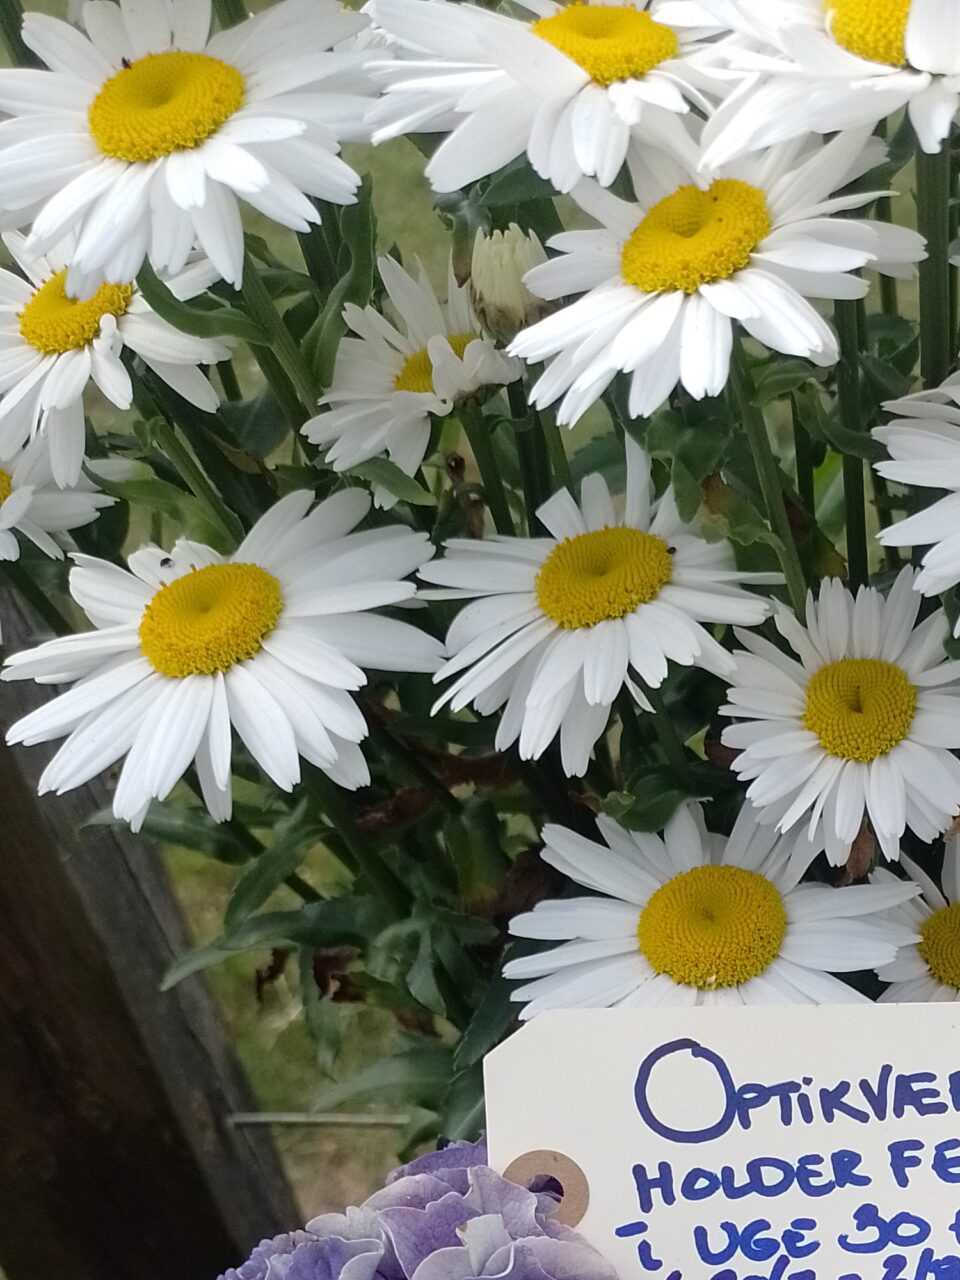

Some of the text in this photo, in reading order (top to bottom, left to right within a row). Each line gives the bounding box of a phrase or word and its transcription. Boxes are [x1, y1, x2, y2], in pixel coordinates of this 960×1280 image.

[632, 1149, 872, 1213] HOLDER
[694, 1218, 821, 1265] UGE
[838, 1203, 931, 1253] 30
